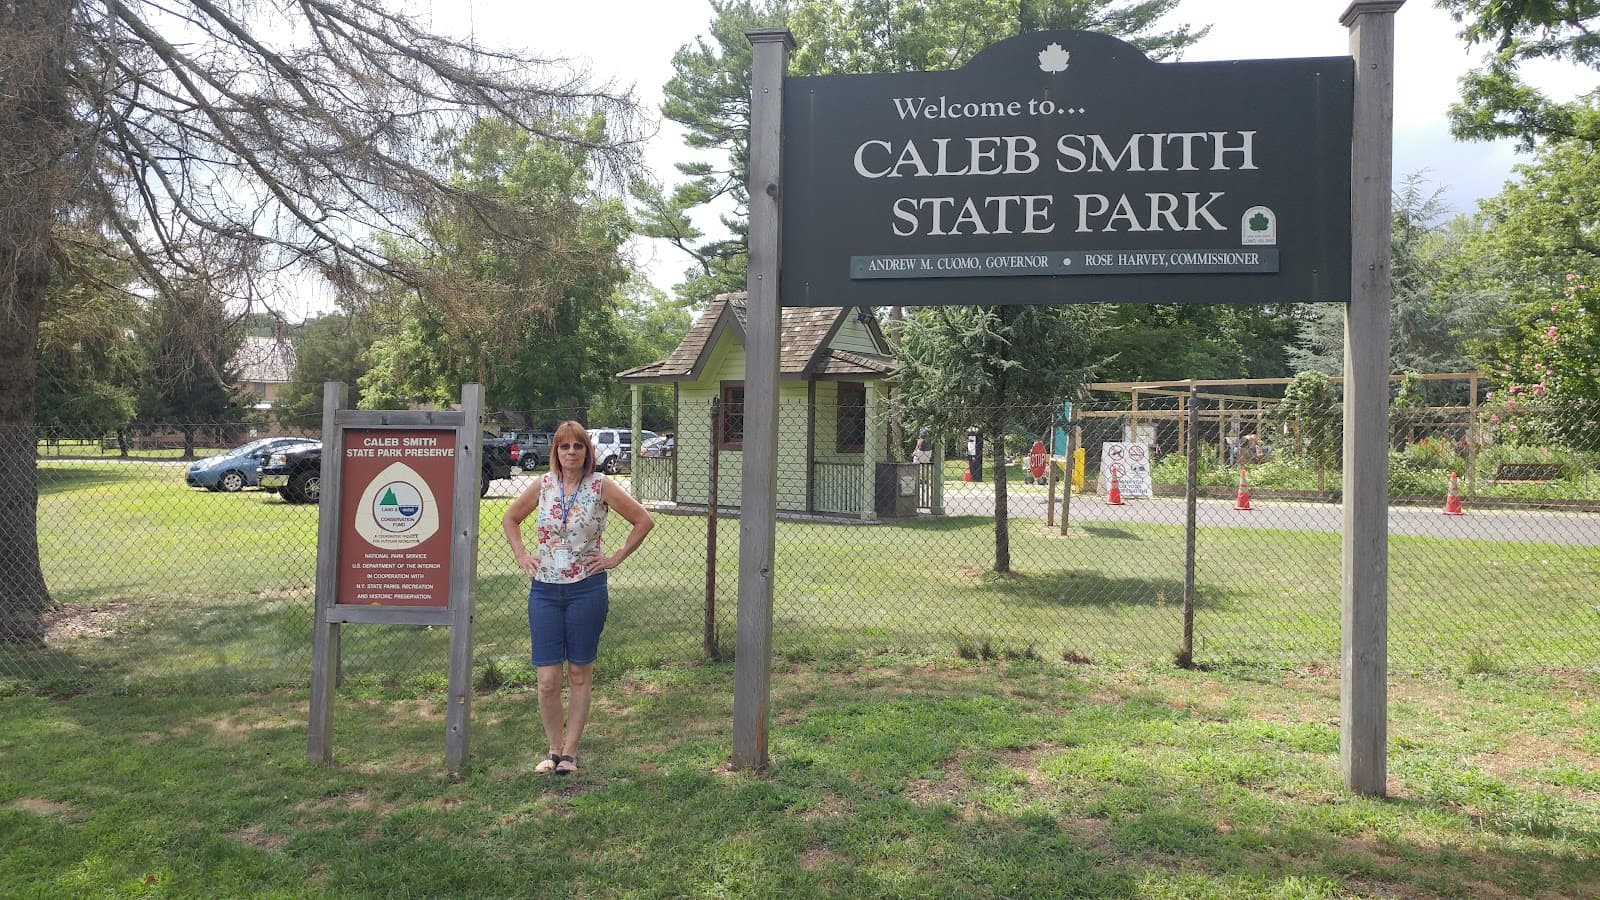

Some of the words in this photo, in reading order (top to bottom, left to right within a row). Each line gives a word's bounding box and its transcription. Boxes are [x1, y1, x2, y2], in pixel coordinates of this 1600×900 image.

[893, 95, 1021, 120] Welcome
[1028, 98, 1086, 116] to...
[853, 135, 1040, 178] CALEB
[1056, 130, 1259, 173] SMITH
[892, 195, 1056, 236] STATE
[1073, 191, 1228, 233] PARK
[868, 258, 916, 271] ANDREW
[920, 258, 933, 270] M.
[937, 257, 982, 270] CUOMO,
[986, 255, 1049, 268] GOVERNOR
[1085, 254, 1113, 266] ROSE
[1118, 253, 1168, 267] HARVEY,
[1170, 252, 1259, 265] COMMISSIONER
[364, 437, 399, 446] CALEB
[402, 437, 437, 446] SMITH
[346, 448, 375, 457] STATE
[377, 448, 402, 457] PARK
[405, 448, 454, 457] PRESERVE
[1031, 453, 1046, 468] STOP
